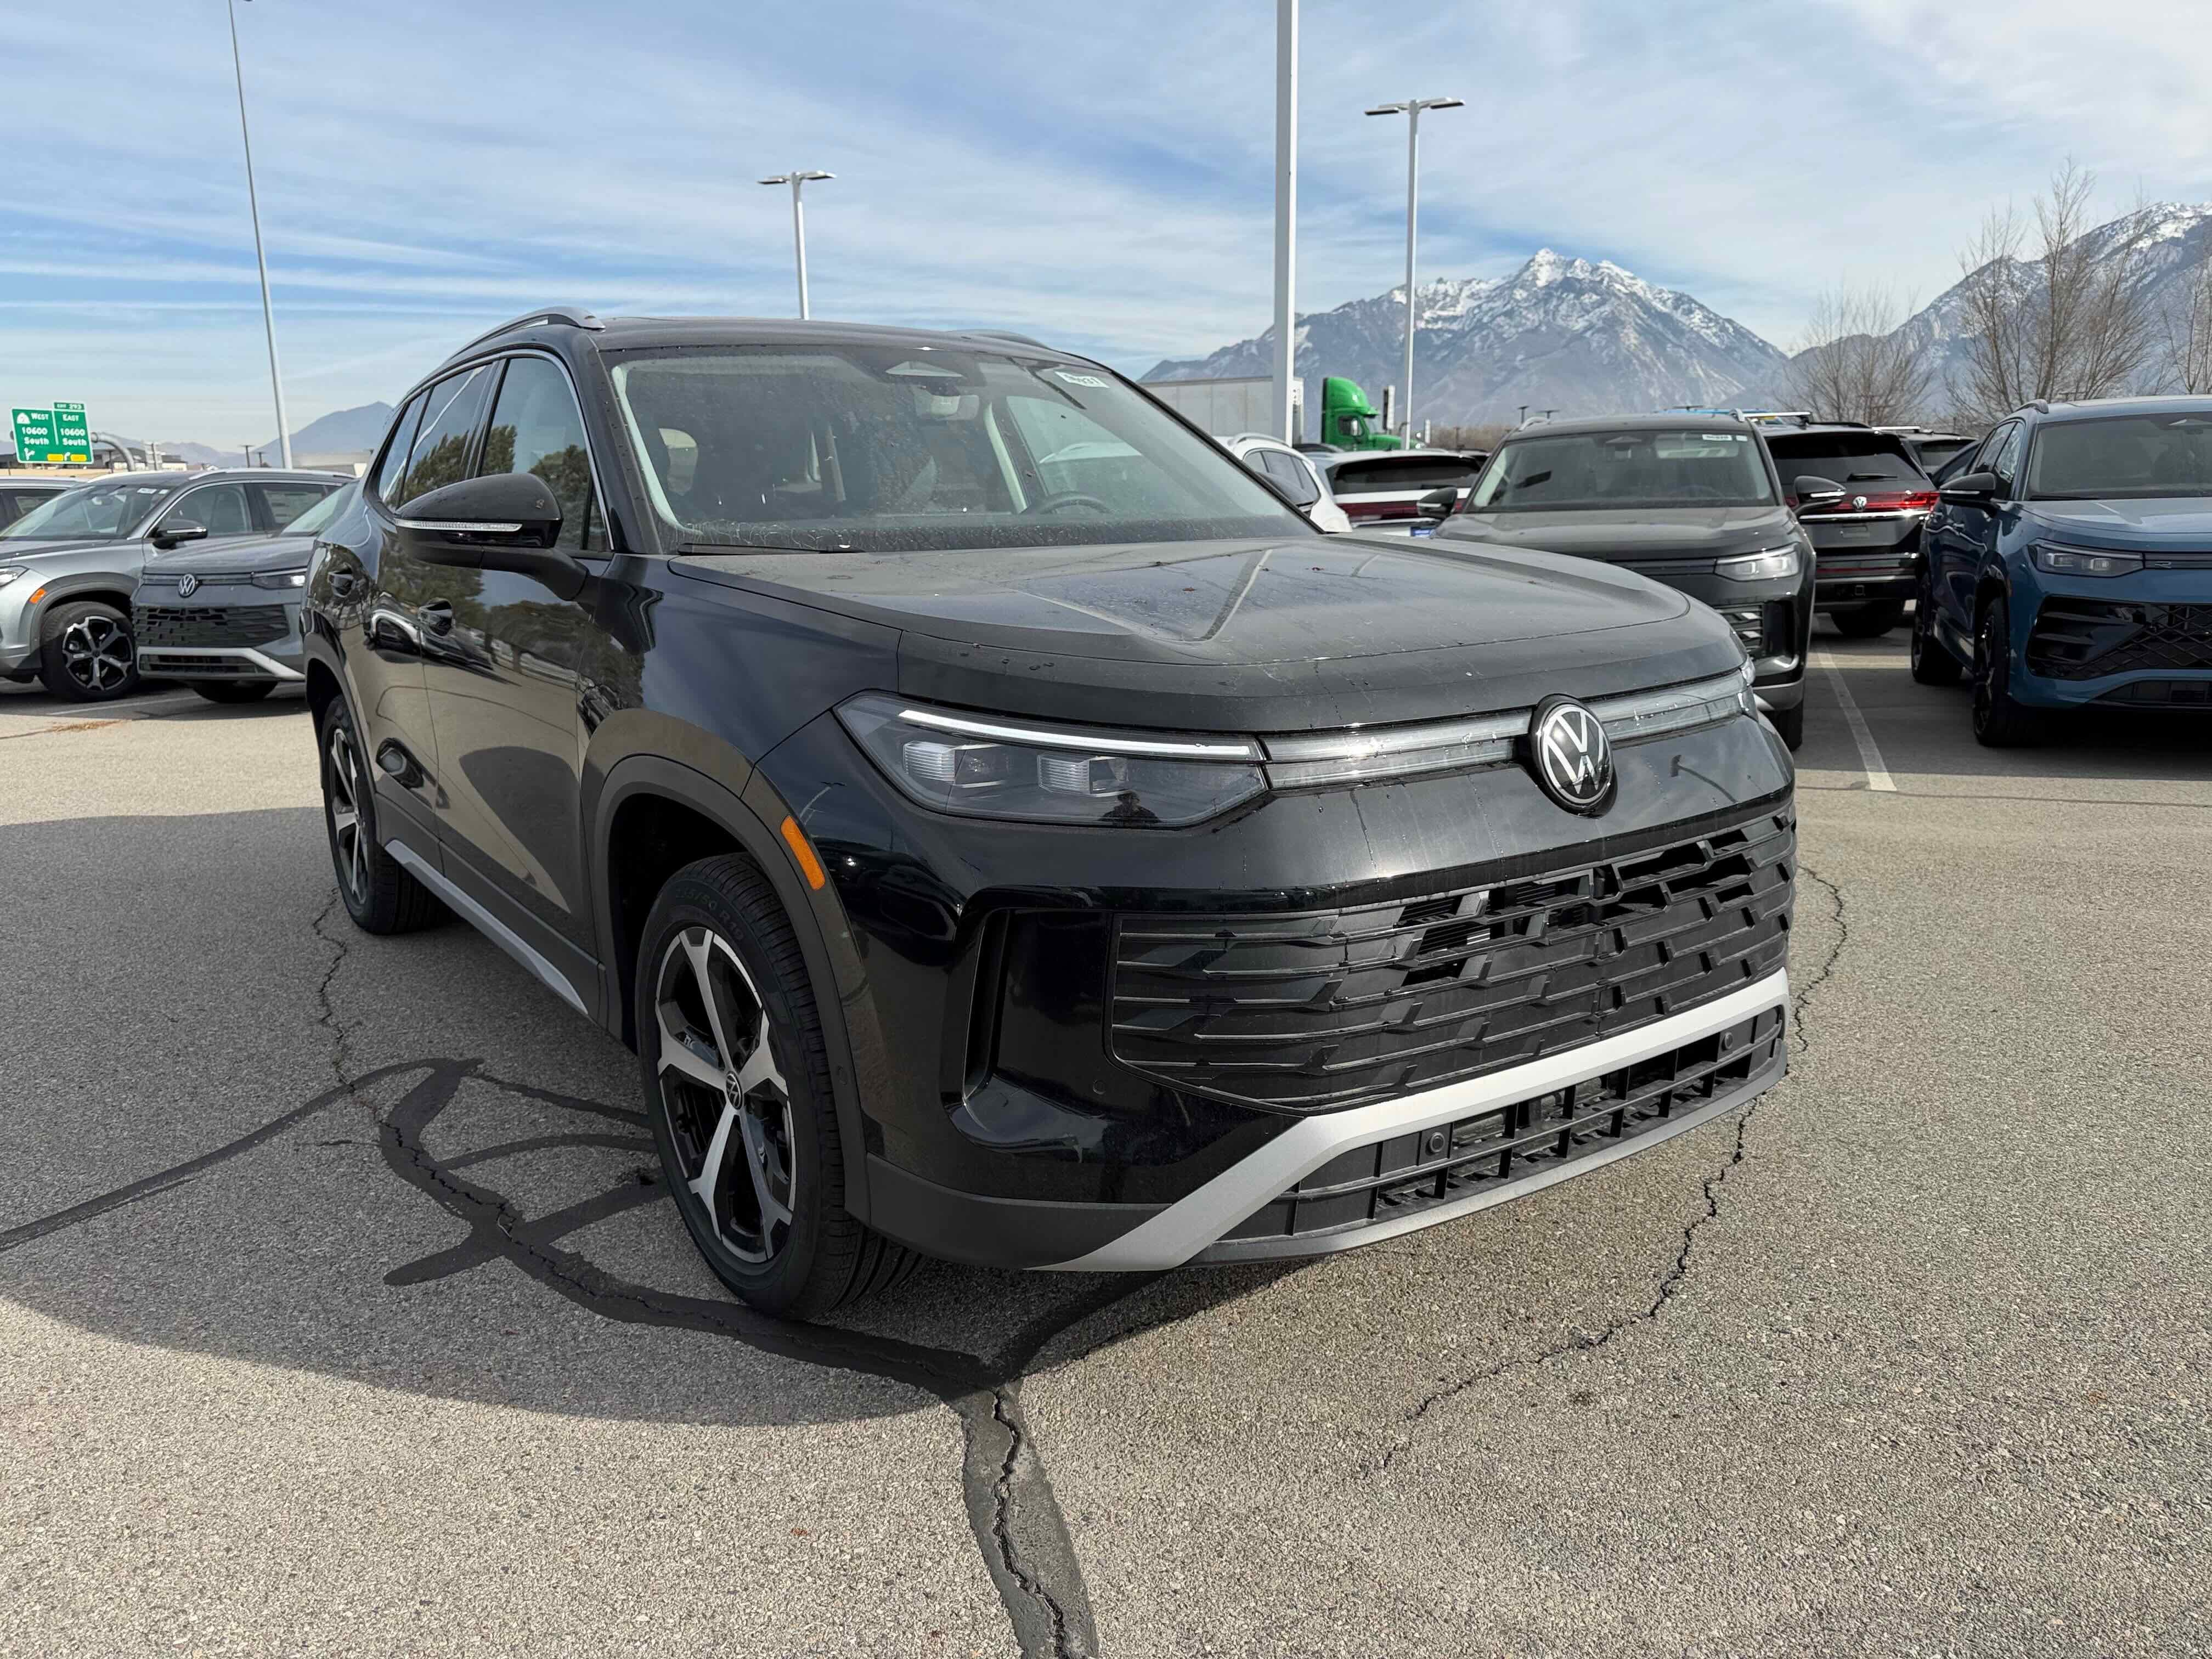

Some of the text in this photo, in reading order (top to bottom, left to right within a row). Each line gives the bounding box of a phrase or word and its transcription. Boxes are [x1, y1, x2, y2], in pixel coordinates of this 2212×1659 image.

[21, 427, 48, 435] 10600
[60, 428, 86, 436] 10600
[24, 437, 49, 445] South
[179, 574, 195, 596] VW
[1539, 704, 1611, 804] VW
